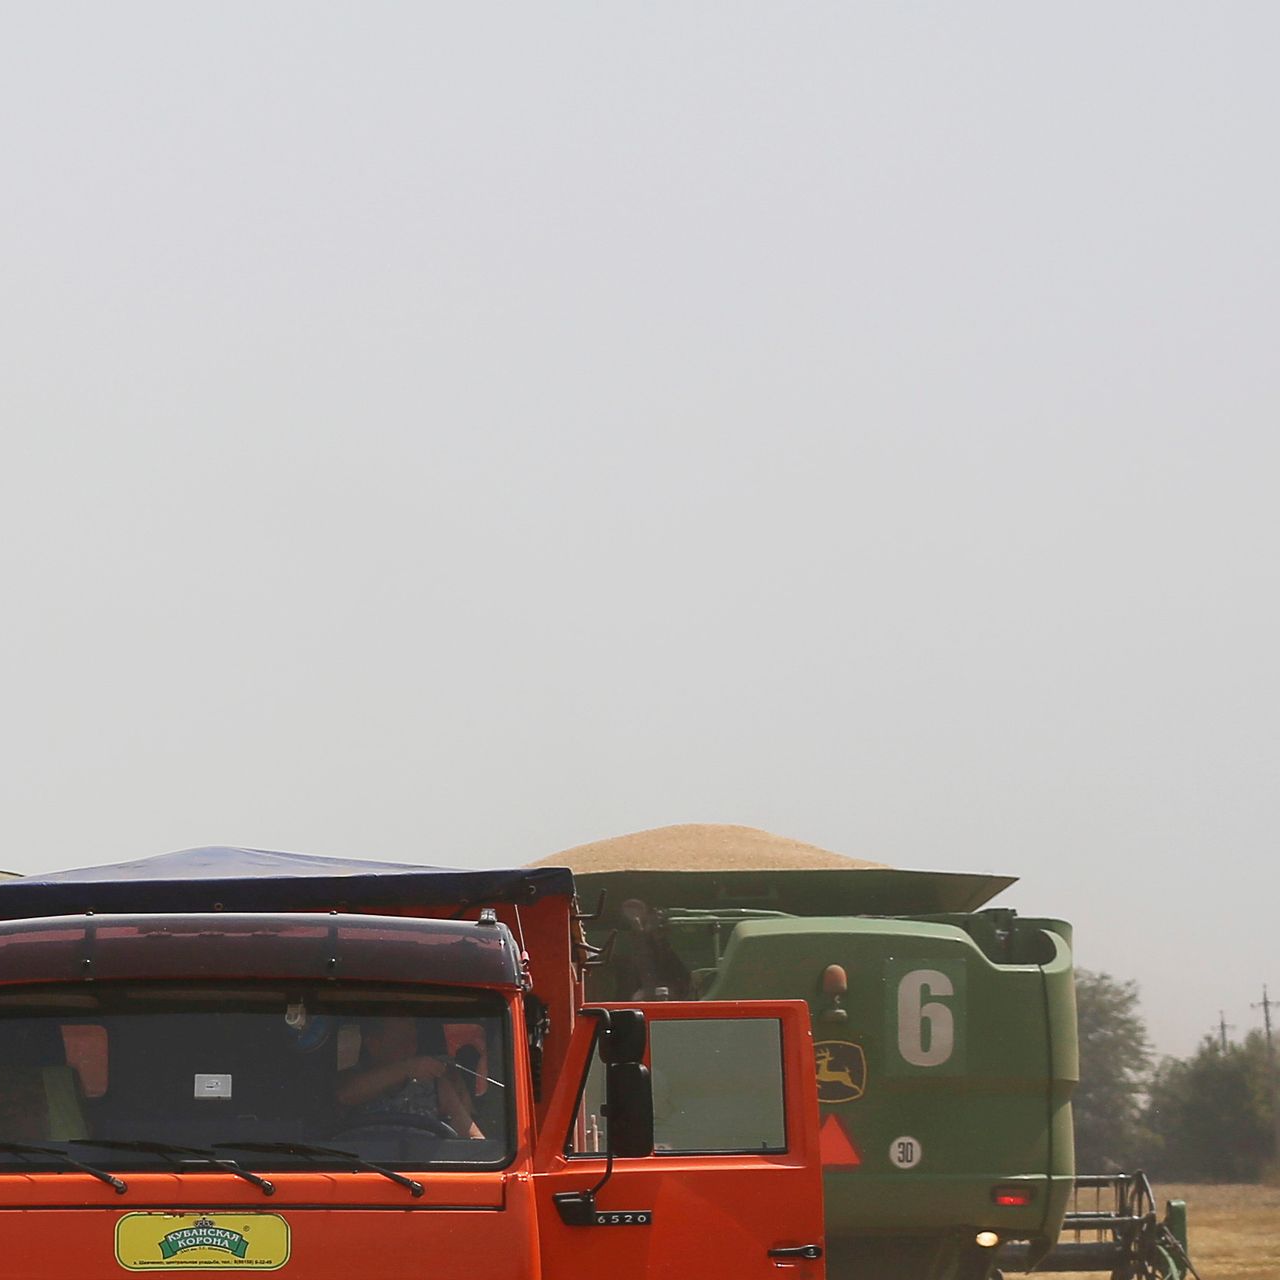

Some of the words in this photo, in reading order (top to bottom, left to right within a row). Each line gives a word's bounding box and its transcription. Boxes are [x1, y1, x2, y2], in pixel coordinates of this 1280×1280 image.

[898, 969, 954, 1067] 6
[897, 1142, 914, 1163] 30
[597, 1213, 647, 1224] 6520
[167, 1228, 240, 1242] КУБАНСКАЯ
[178, 1237, 230, 1248] КОРОНА
